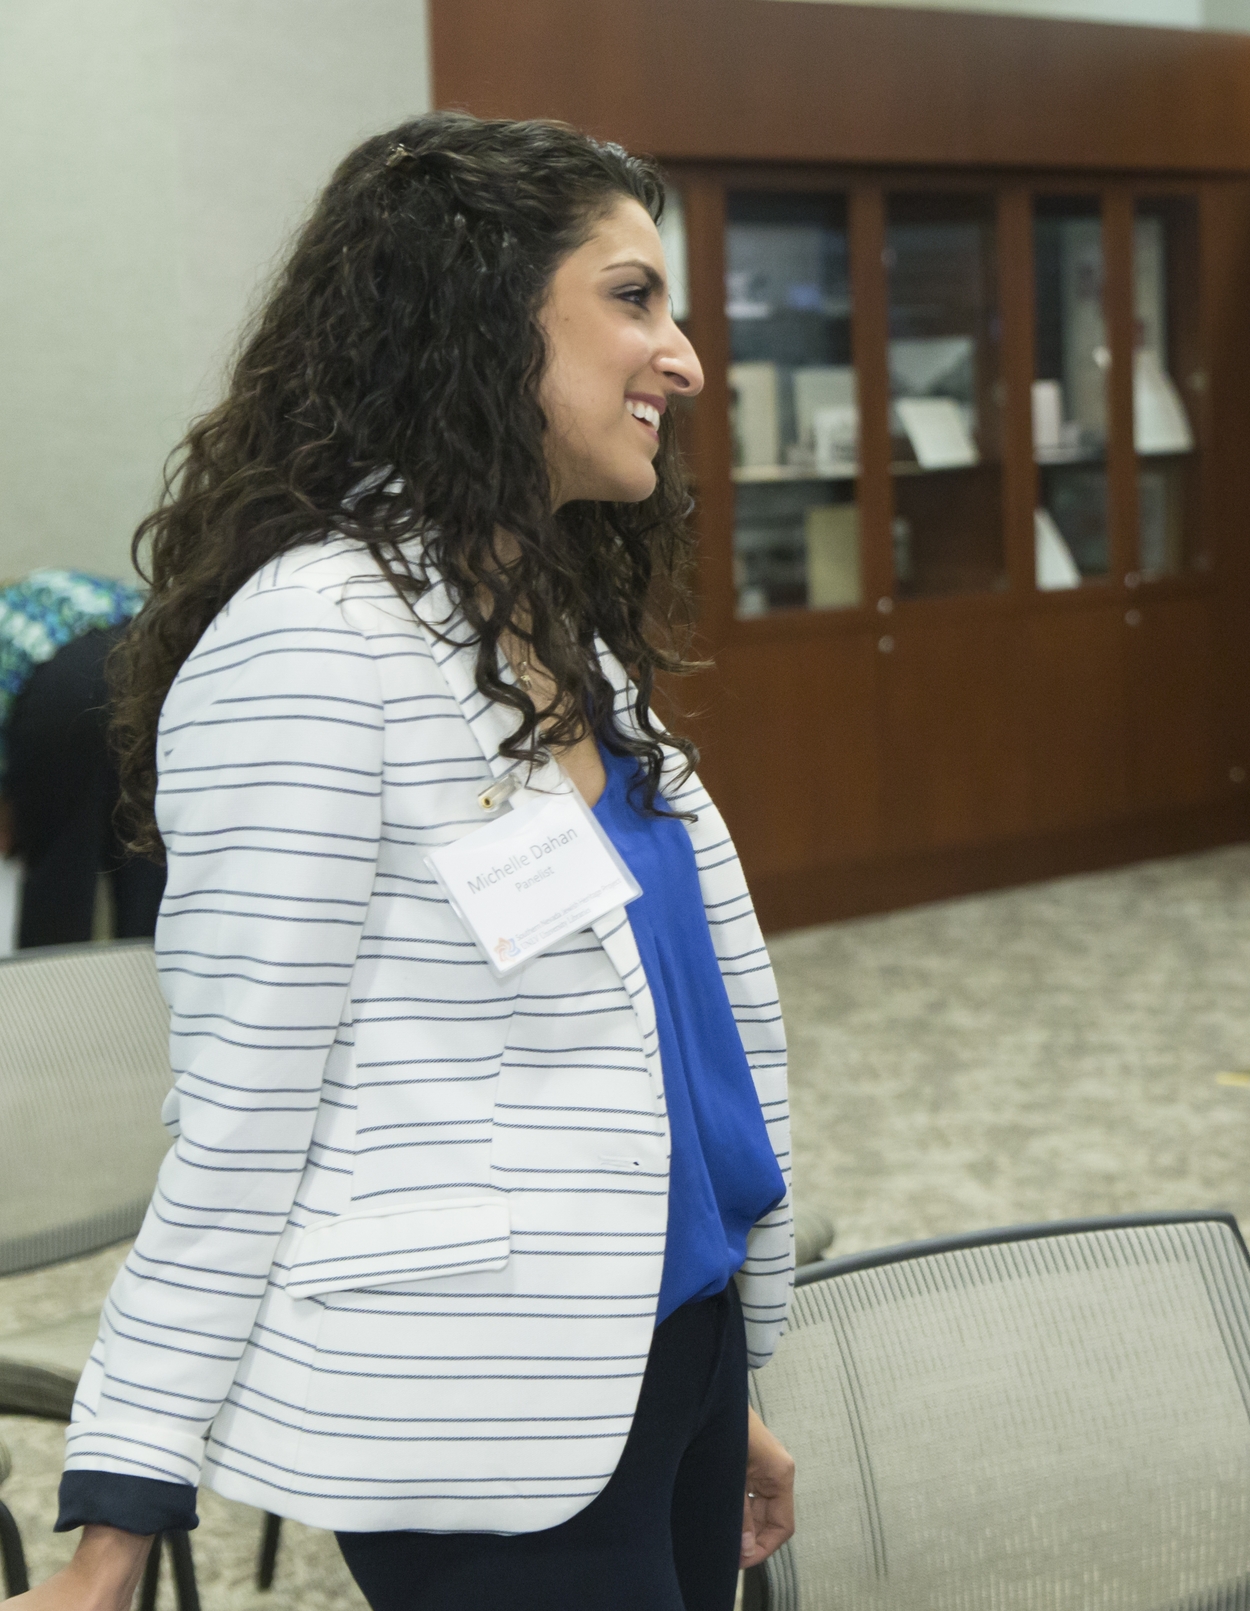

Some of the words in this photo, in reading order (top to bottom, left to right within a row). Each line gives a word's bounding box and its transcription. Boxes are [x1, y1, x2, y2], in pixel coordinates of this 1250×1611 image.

[466, 852, 531, 894] Michelle
[530, 828, 578, 859] Dahan
[515, 866, 555, 891] Panelist
